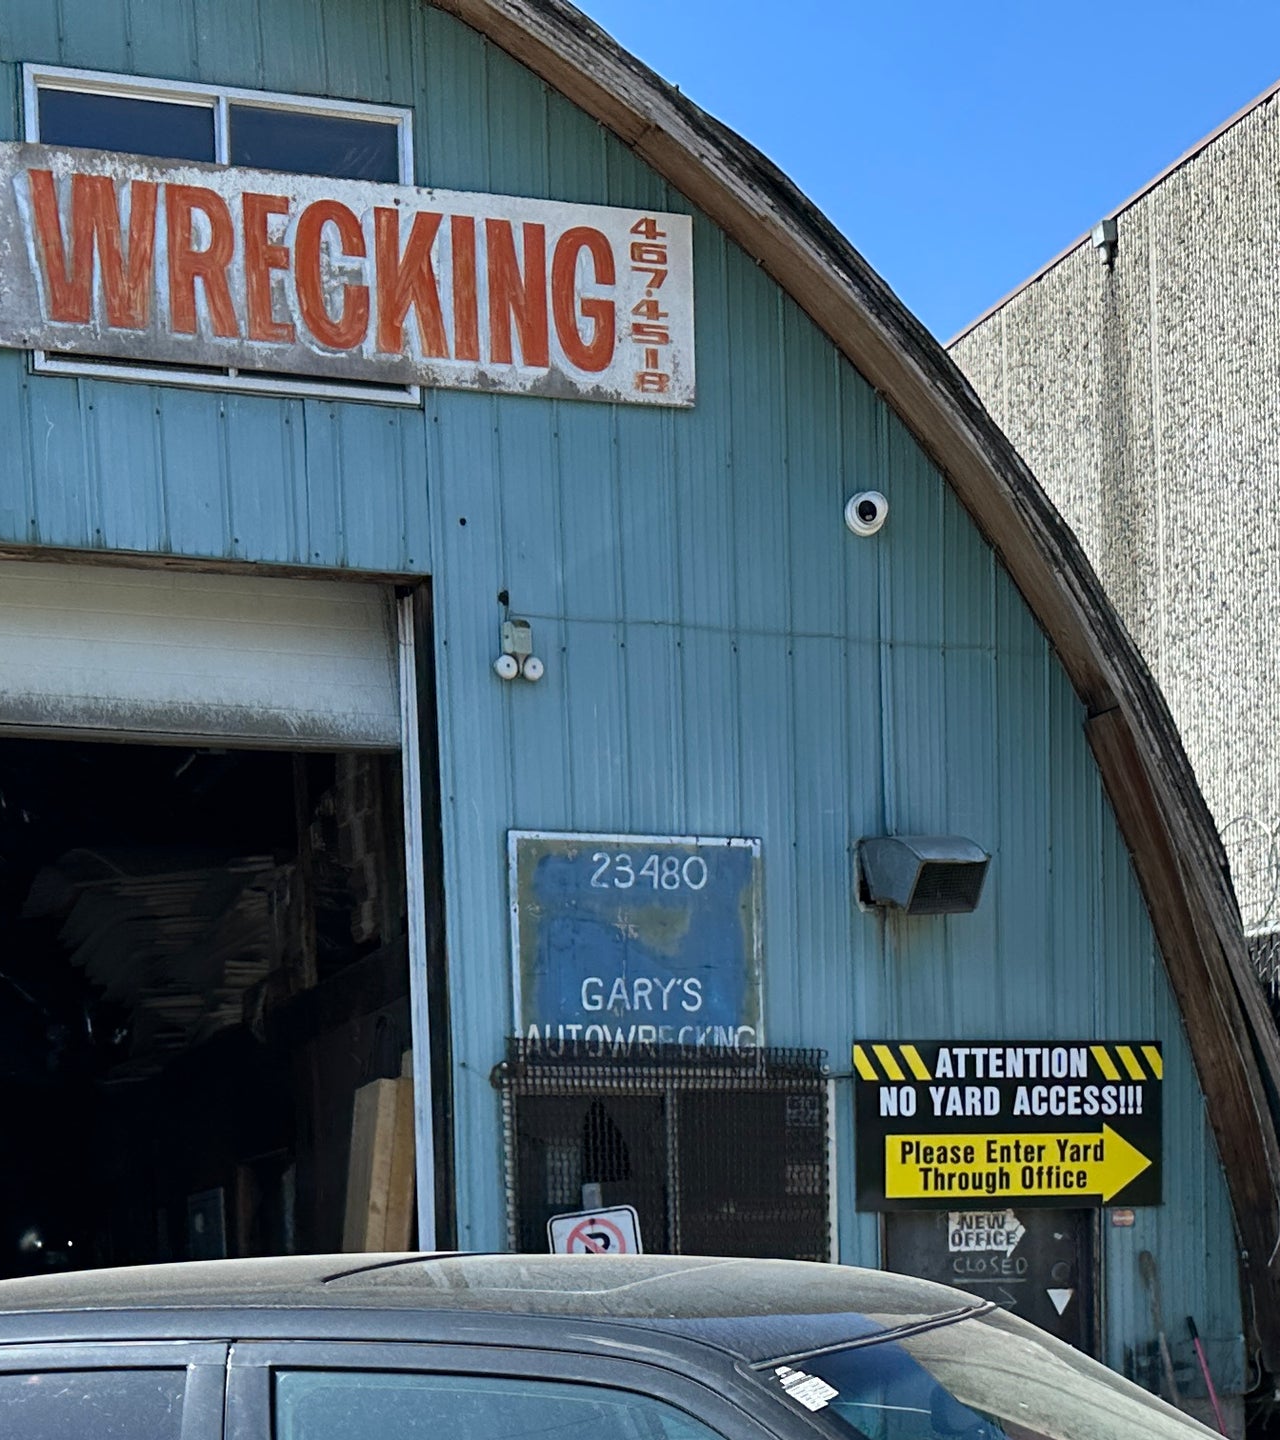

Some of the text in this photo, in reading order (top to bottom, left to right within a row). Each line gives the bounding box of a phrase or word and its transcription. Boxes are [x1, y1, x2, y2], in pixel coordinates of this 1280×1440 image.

[28, 168, 618, 373] WRECKING
[590, 852, 708, 890] 23480
[581, 976, 703, 1012] GARY'S
[935, 1047, 1088, 1078] ATTENTION
[879, 1085, 1143, 1117] NO YARD ACCESS!!!
[900, 1138, 1104, 1164] Please Enter Yard
[919, 1166, 1087, 1194] Through Office
[959, 1214, 1006, 1230] NEW
[950, 1229, 1018, 1247] OFFICE
[952, 1256, 1029, 1275] CLOSED
